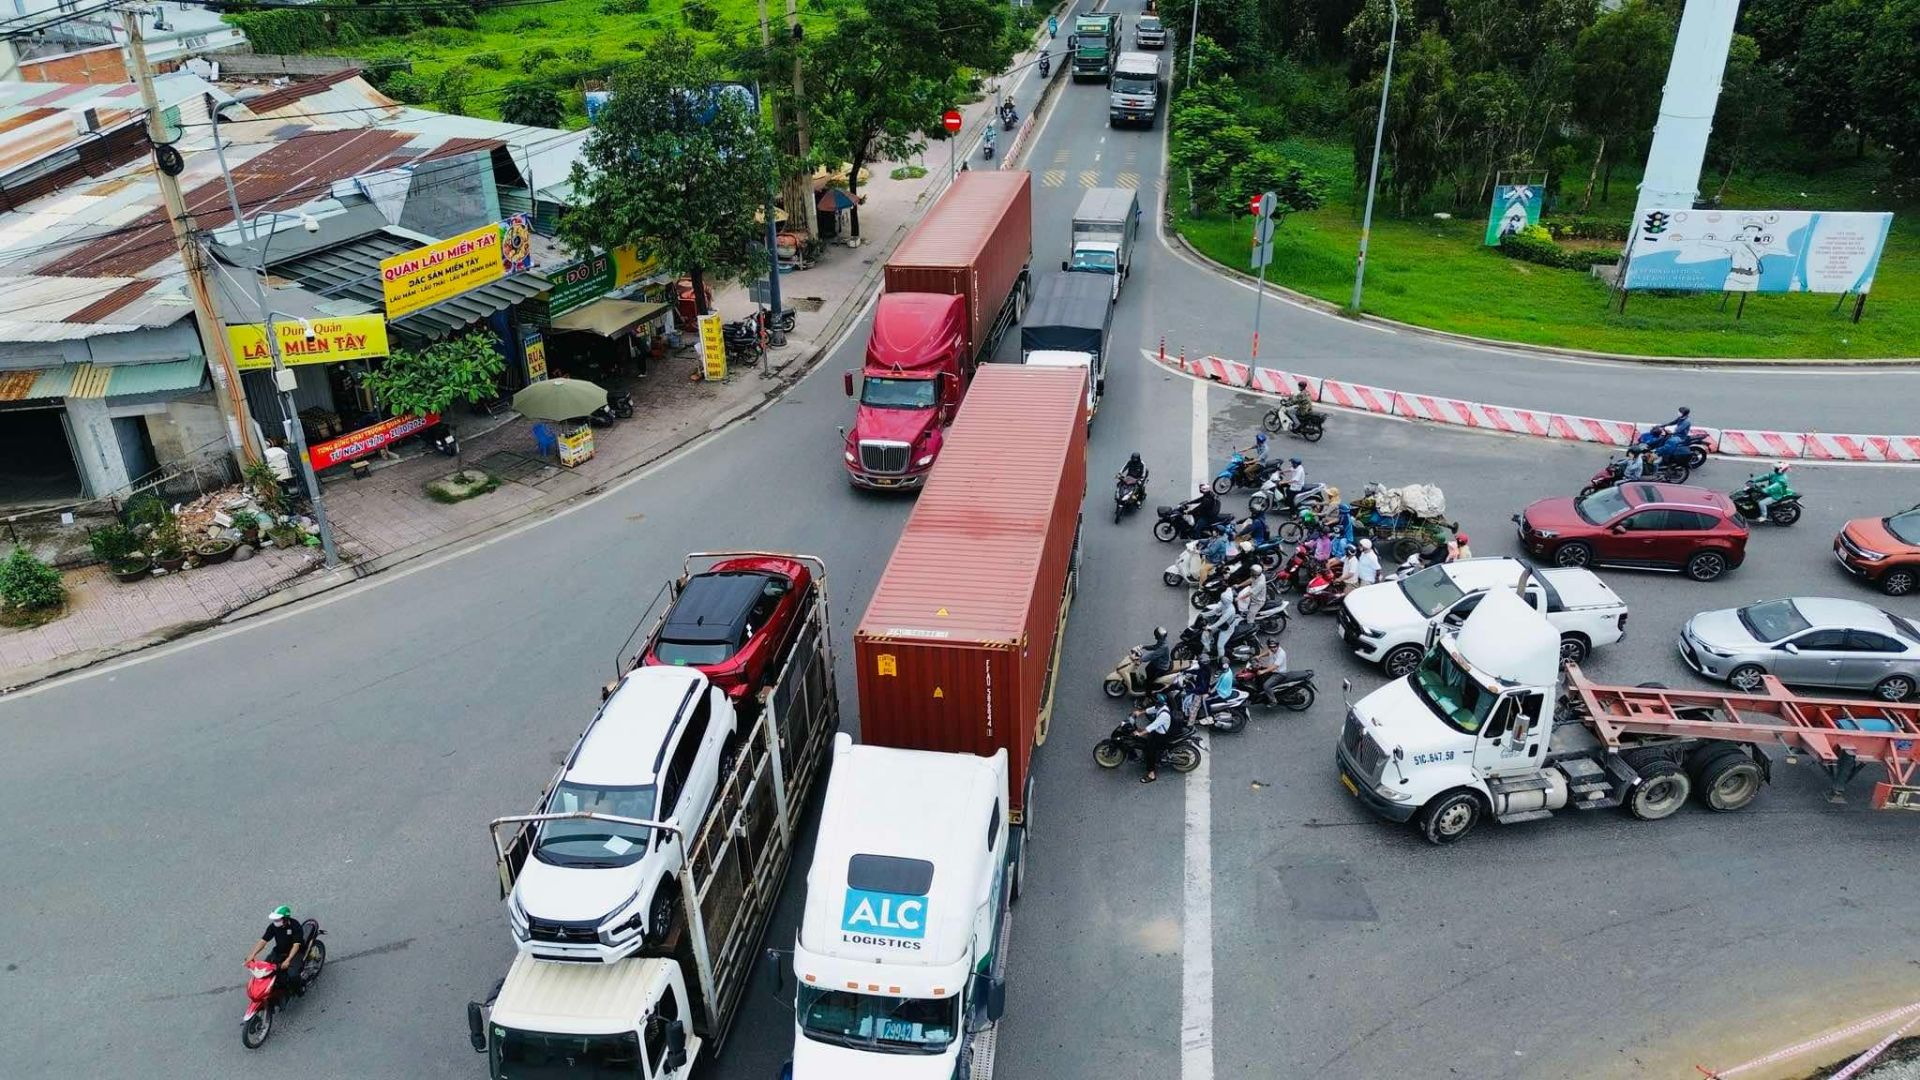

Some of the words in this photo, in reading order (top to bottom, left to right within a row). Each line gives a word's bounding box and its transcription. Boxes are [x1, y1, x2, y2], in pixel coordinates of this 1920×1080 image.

[476, 233, 497, 249] TÂY
[282, 325, 311, 338] Dun
[334, 332, 367, 352] TÂY
[848, 896, 922, 930] ALC
[843, 934, 921, 950] LOGISTICS
